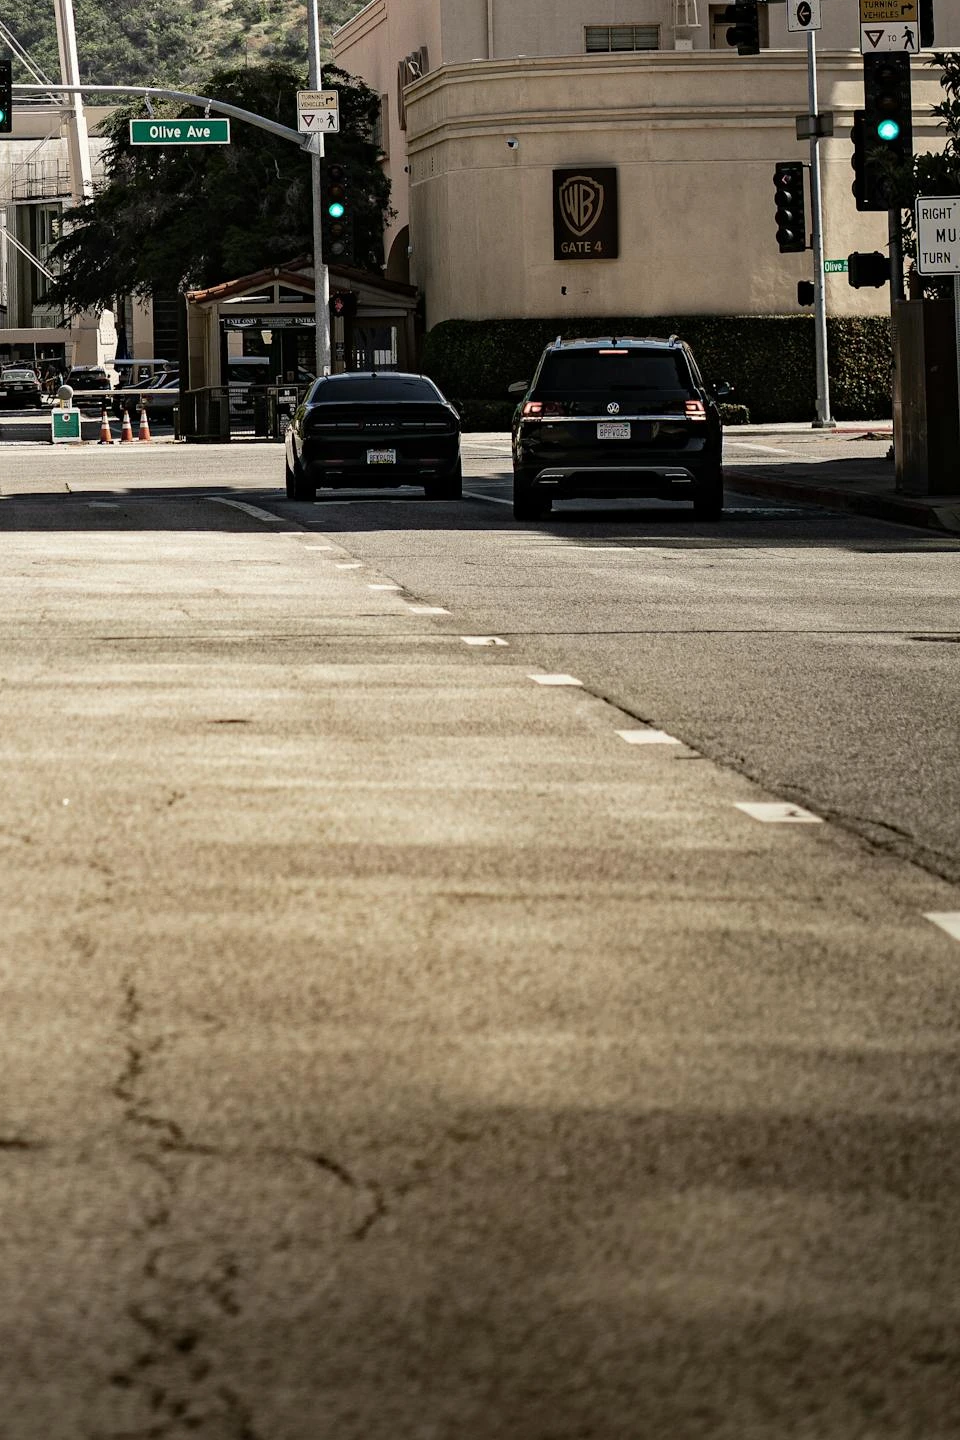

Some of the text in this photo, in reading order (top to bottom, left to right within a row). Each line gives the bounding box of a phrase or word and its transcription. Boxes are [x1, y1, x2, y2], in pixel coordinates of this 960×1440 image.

[864, 0, 898, 9] TURNING
[864, 11, 899, 19] VEHICLES
[888, 34, 897, 42] TO
[149, 125, 211, 138] Olive Ave
[564, 184, 595, 227] WB
[922, 208, 952, 220] RIGHT
[936, 228, 960, 242] MU
[561, 241, 602, 253] GATE 4
[923, 252, 951, 264] TURN
[824, 261, 842, 272] Olive
